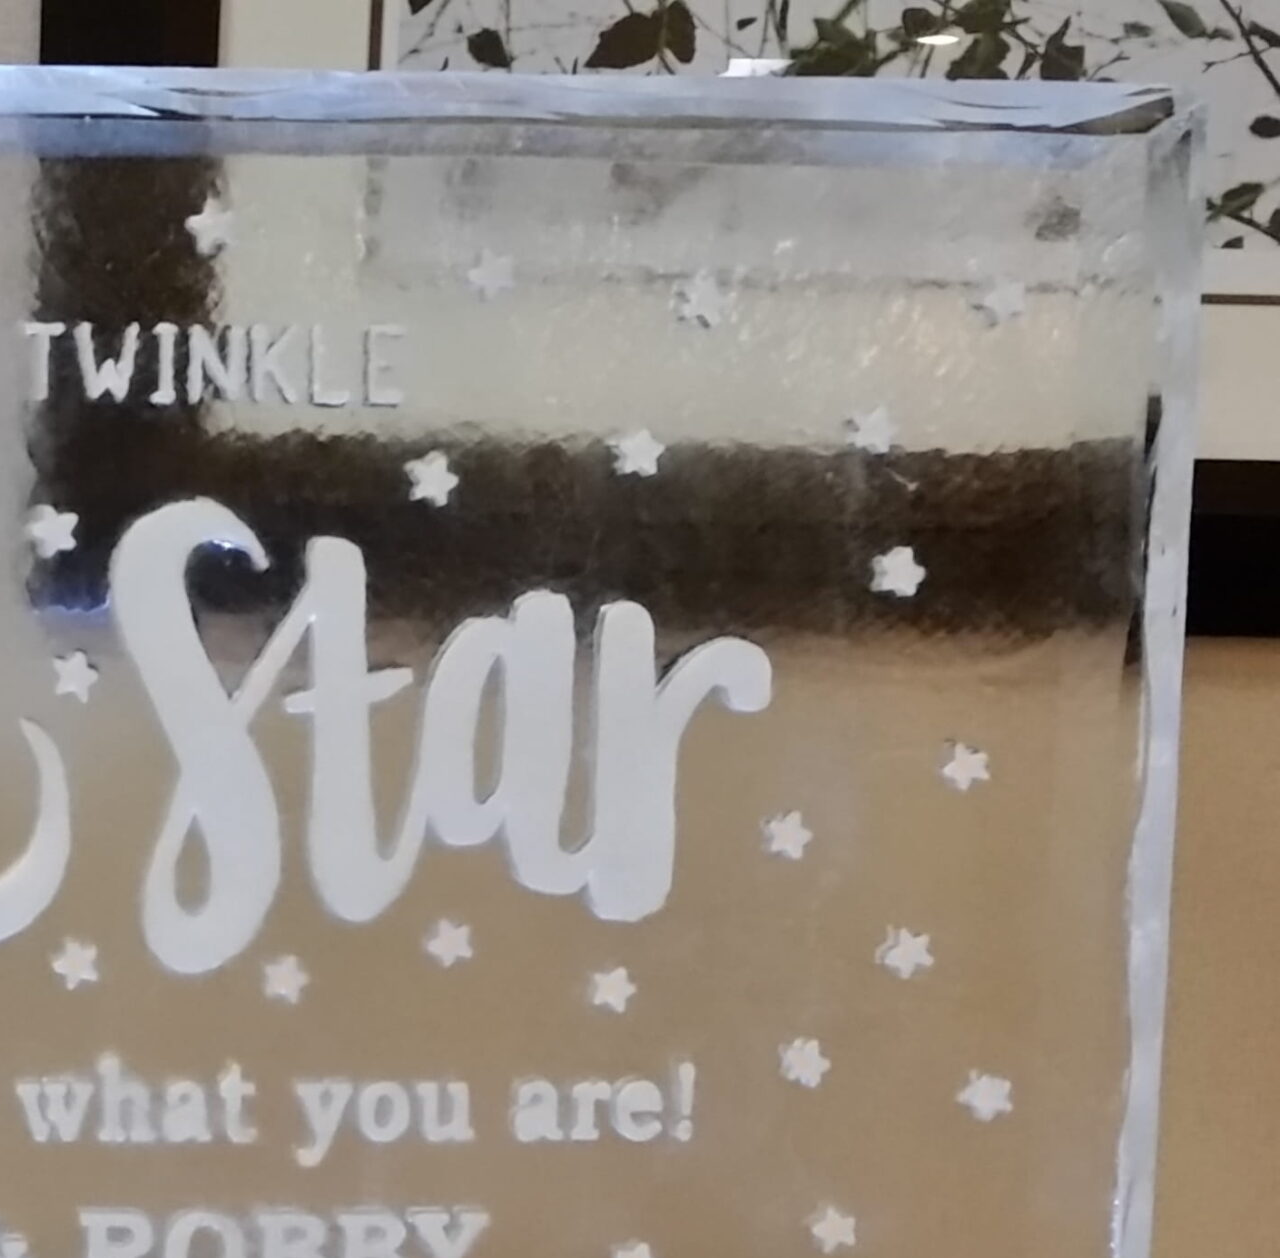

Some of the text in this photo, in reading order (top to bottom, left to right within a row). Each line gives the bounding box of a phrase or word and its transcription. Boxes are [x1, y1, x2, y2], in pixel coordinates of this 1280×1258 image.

[24, 318, 405, 405] TWINKLE
[20, 1054, 258, 1142] what
[293, 1079, 475, 1168] you
[510, 1060, 698, 1142] are!
